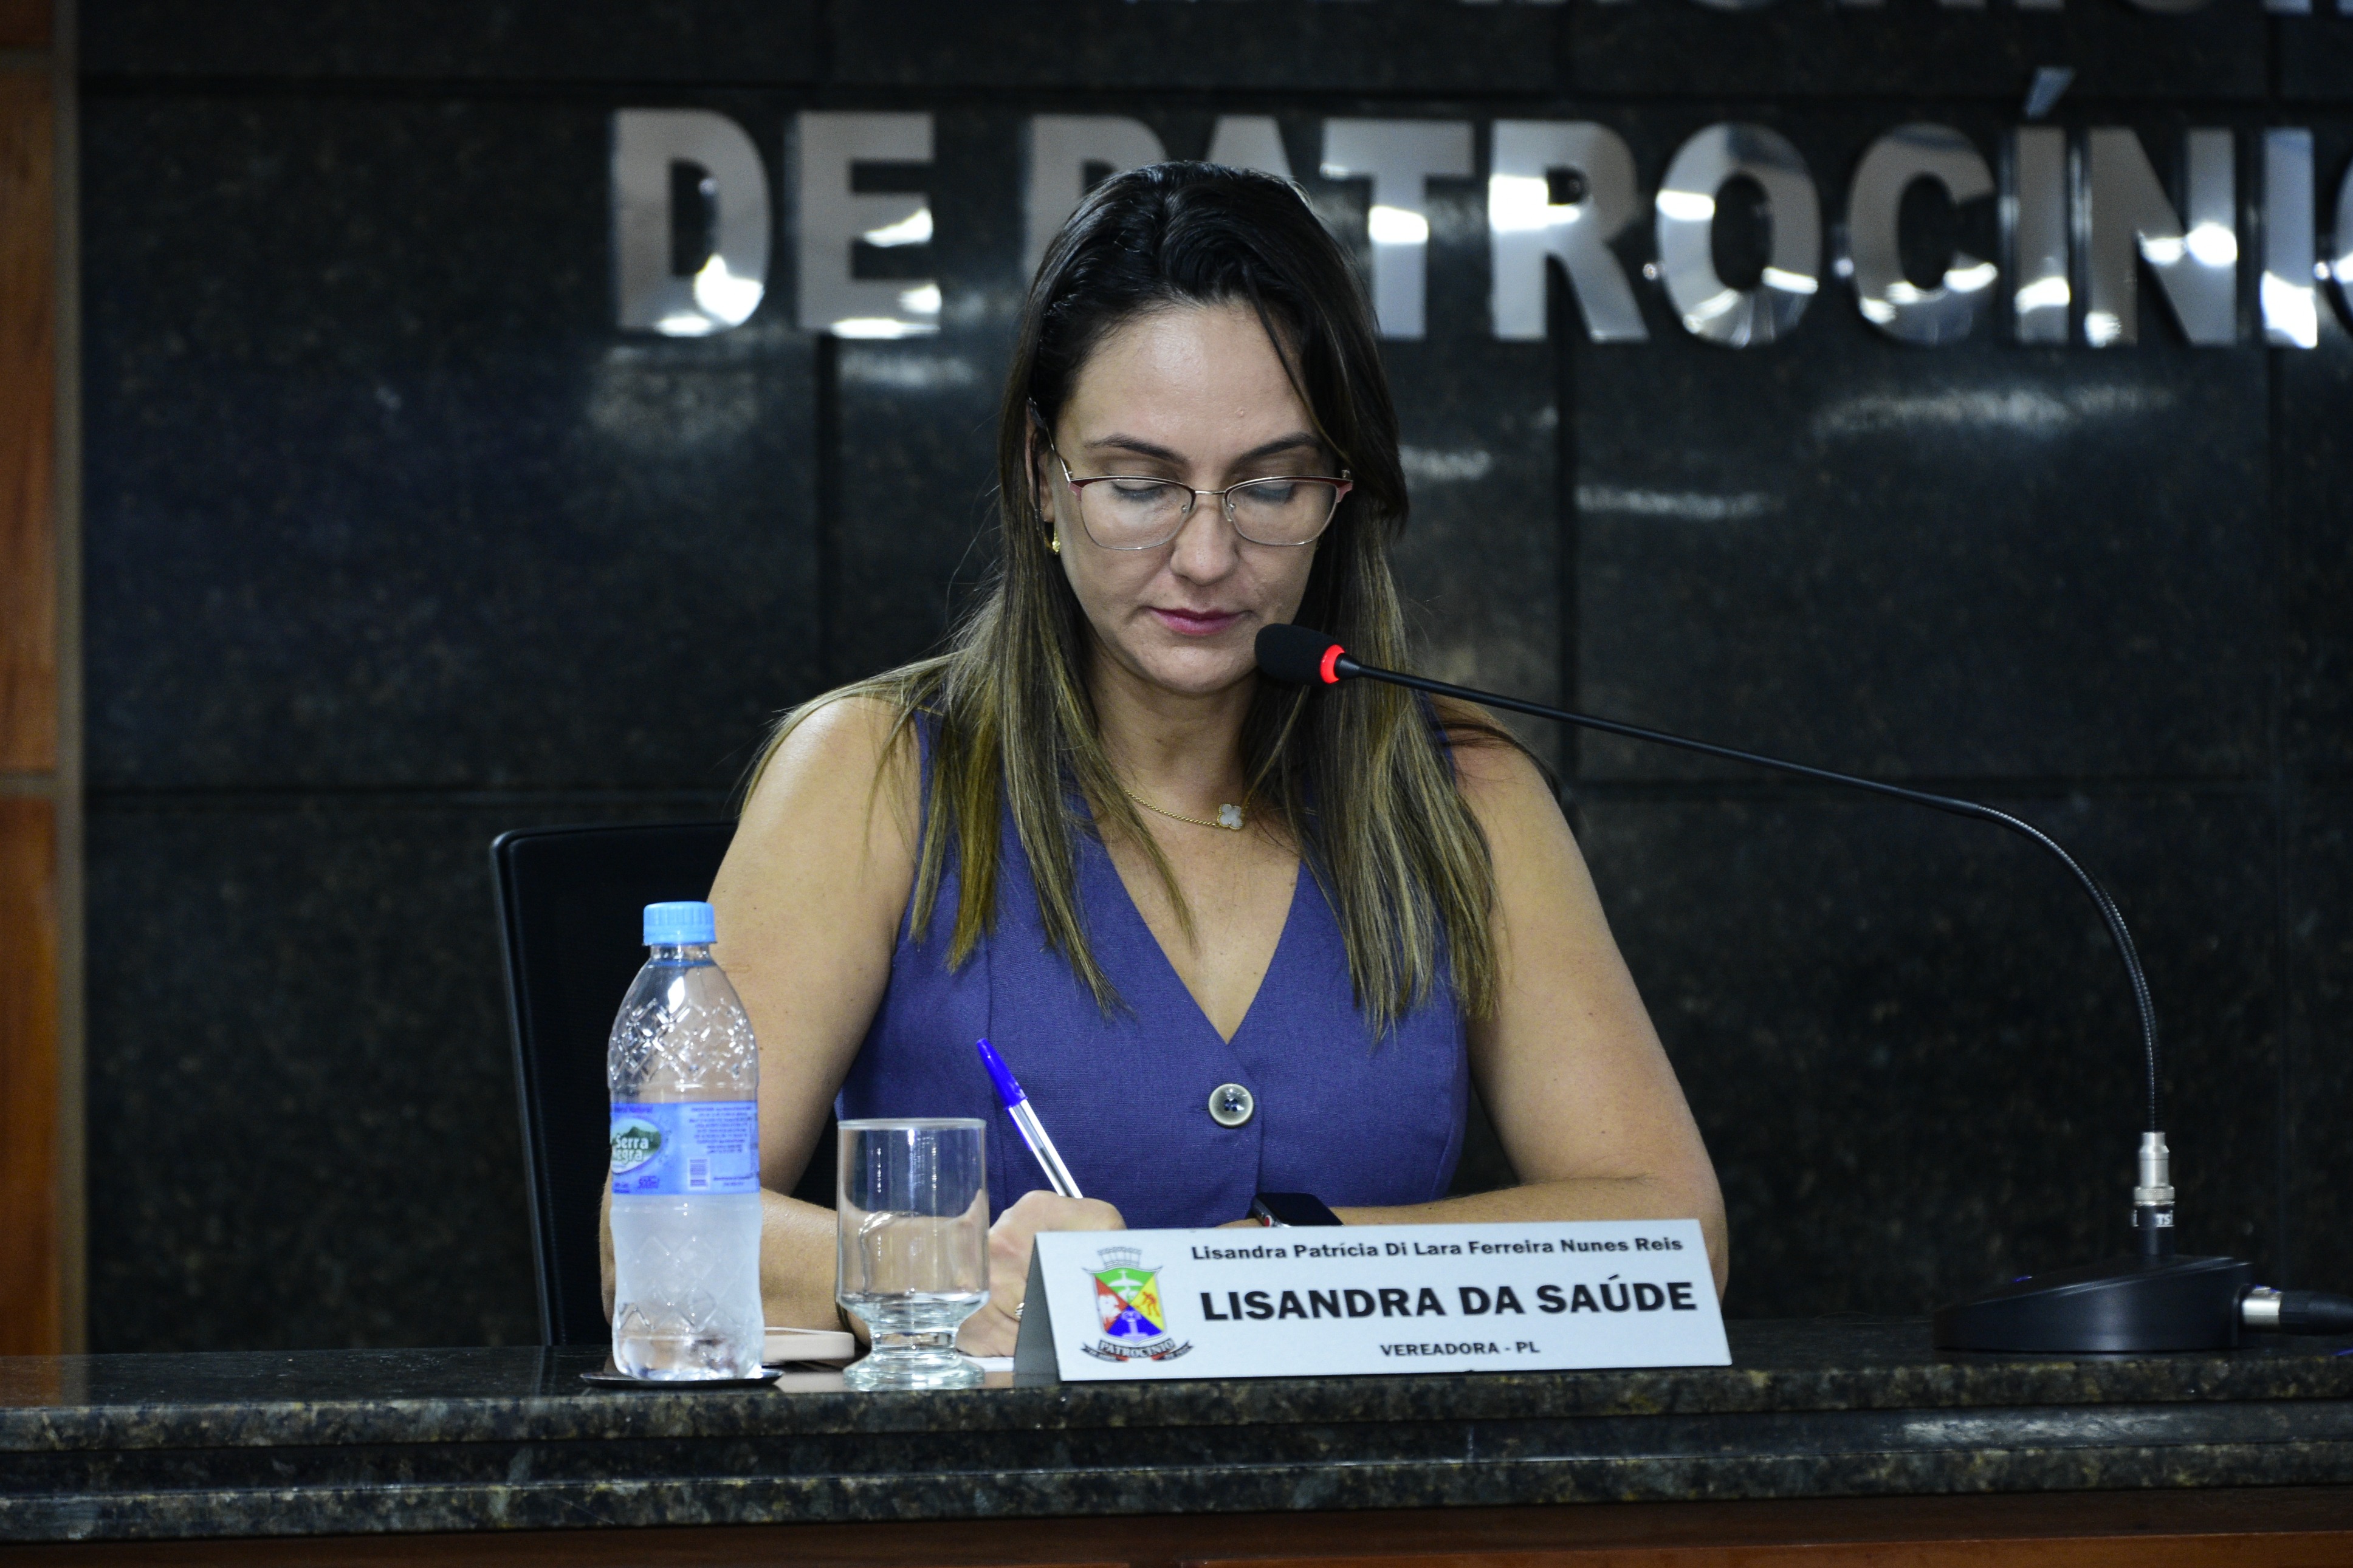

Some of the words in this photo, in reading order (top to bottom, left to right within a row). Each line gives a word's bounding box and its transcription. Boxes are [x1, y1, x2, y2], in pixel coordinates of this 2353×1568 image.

[613, 107, 941, 337] DE
[616, 1133, 650, 1150] Serra
[1192, 1246, 1287, 1260] Lisandra
[1294, 1243, 1379, 1258] Patrícia
[1386, 1242, 1407, 1256] Di
[1414, 1242, 1462, 1256] Lara
[1468, 1240, 1554, 1255] Ferreira
[1560, 1239, 1629, 1253] Nunes
[1635, 1237, 1683, 1251] Reis
[1200, 1287, 1446, 1321] LISANDRA
[1458, 1286, 1525, 1316] DA
[1536, 1274, 1697, 1314] SAÚDE
[1379, 1342, 1500, 1357] VEREADORA
[1516, 1341, 1541, 1354] PL
